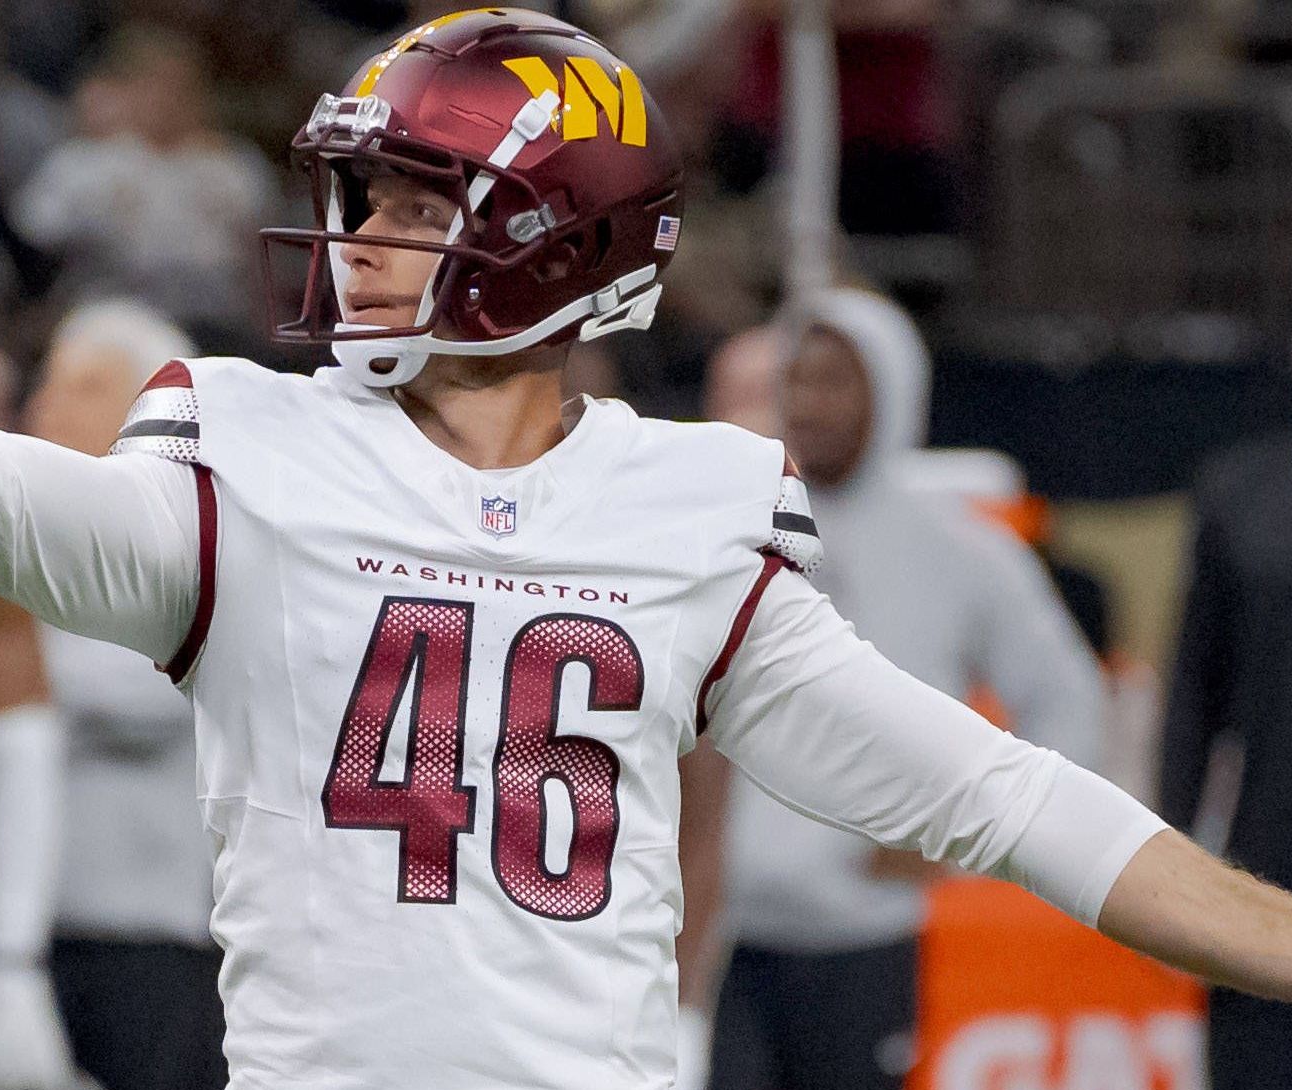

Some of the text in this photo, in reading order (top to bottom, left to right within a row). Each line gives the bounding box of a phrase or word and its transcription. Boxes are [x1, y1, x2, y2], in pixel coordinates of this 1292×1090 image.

[485, 511, 512, 531] NFL
[355, 555, 630, 605] WASHINGTON
[321, 595, 645, 922] 46
